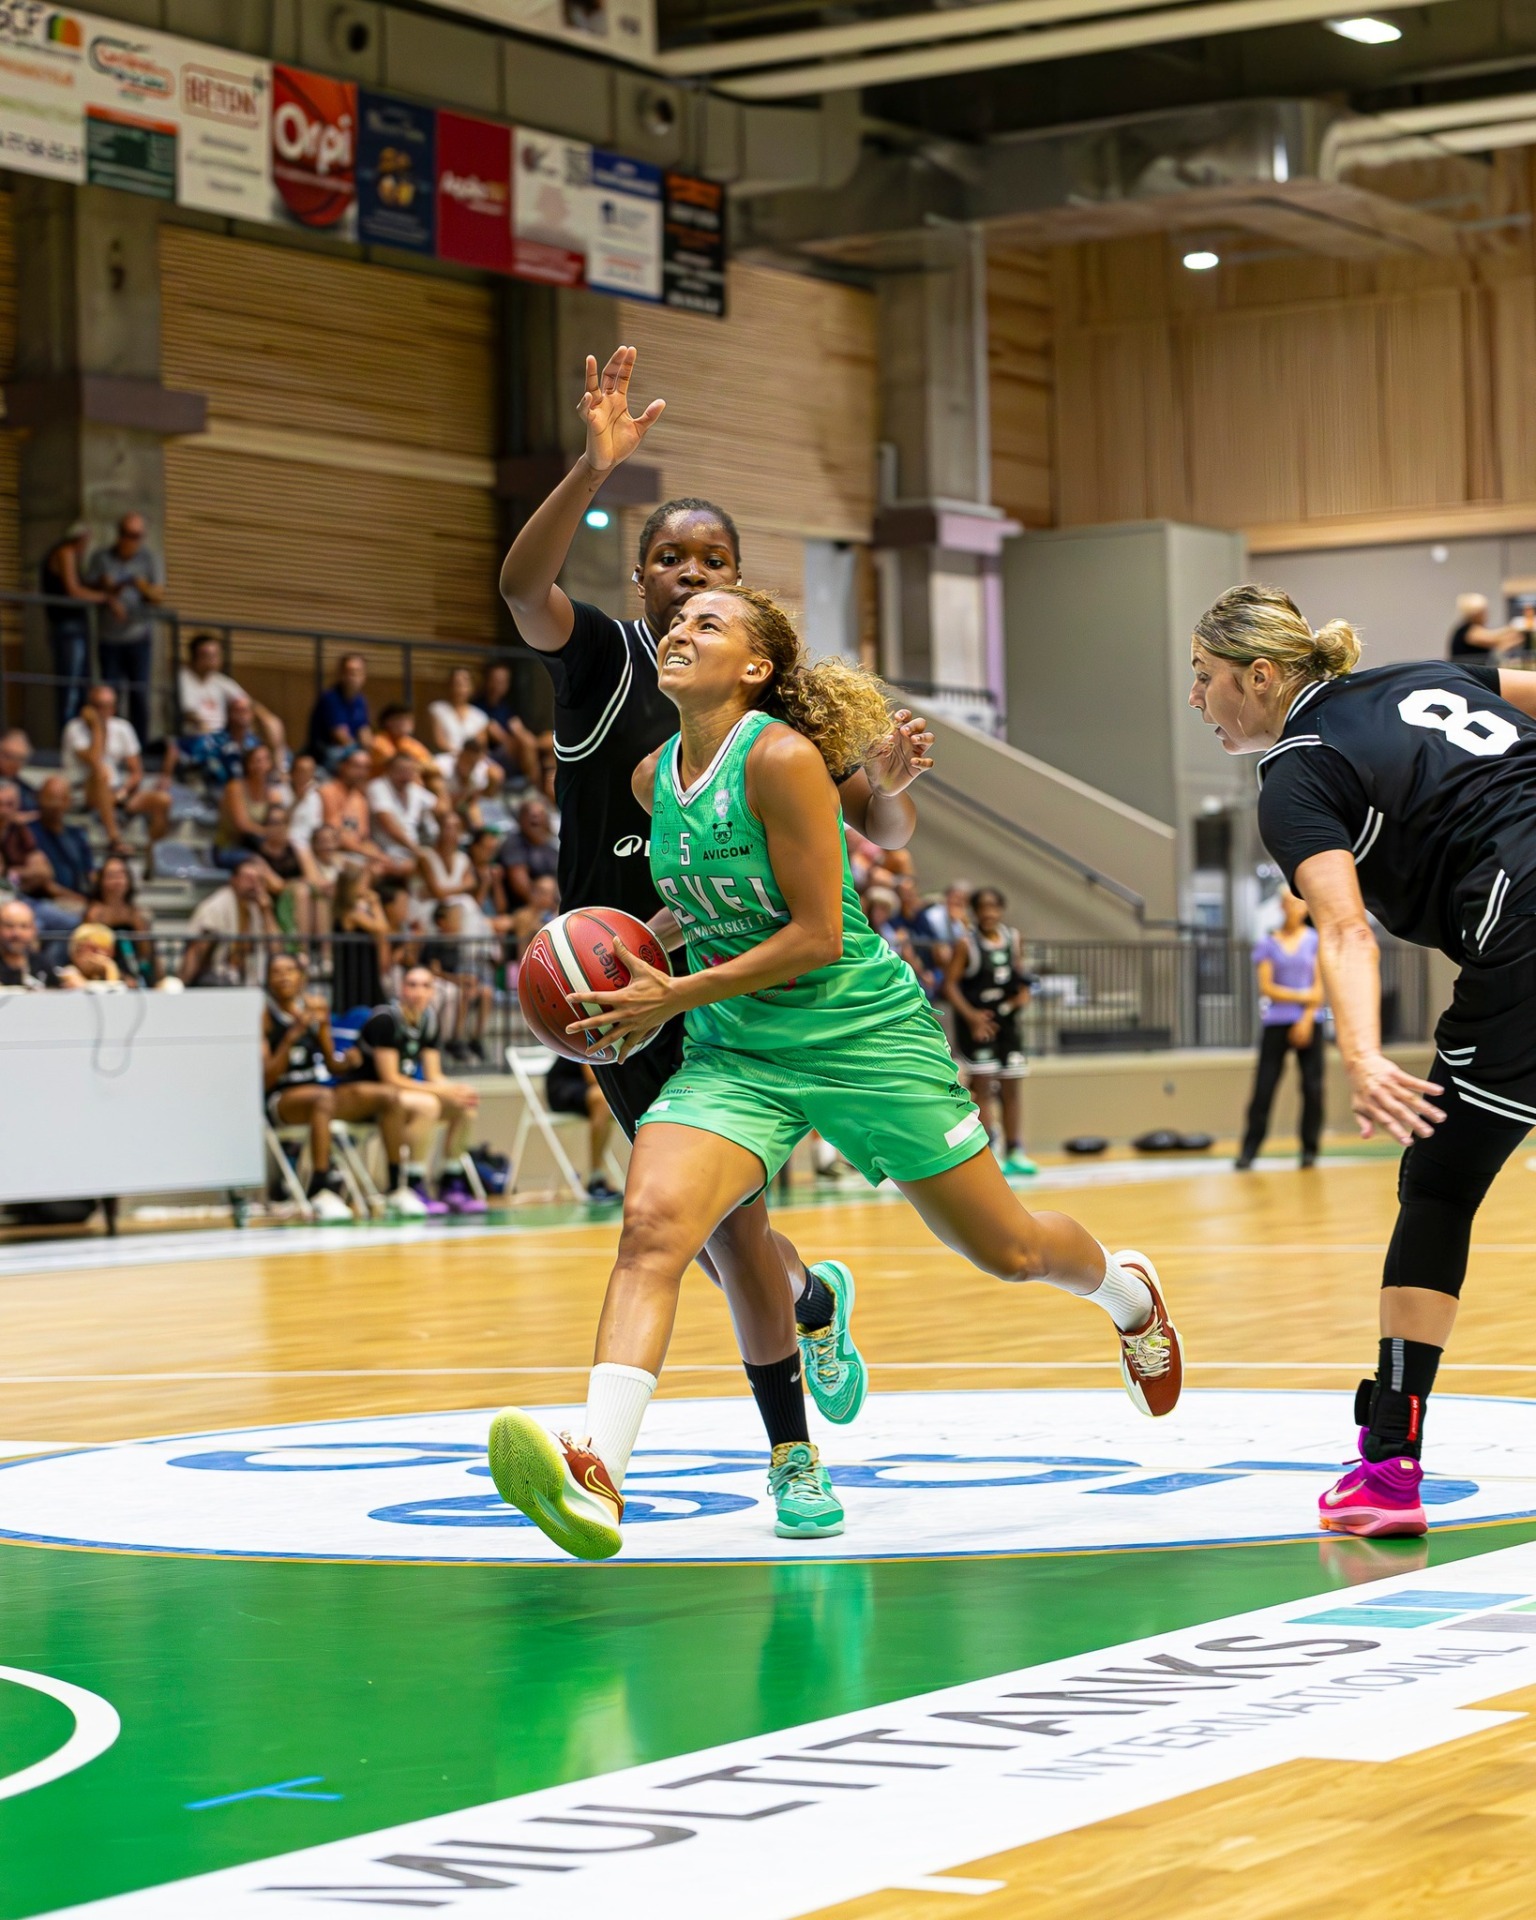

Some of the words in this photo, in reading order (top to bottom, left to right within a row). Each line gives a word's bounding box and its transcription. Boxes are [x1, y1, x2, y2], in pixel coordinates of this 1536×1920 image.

[274, 101, 353, 175] Orpi
[1397, 687, 1521, 757] 8
[679, 832, 691, 866] 5
[1002, 1645, 1529, 1782] INTERNATIONAL
[252, 1634, 1384, 1909] MULTITANKS
